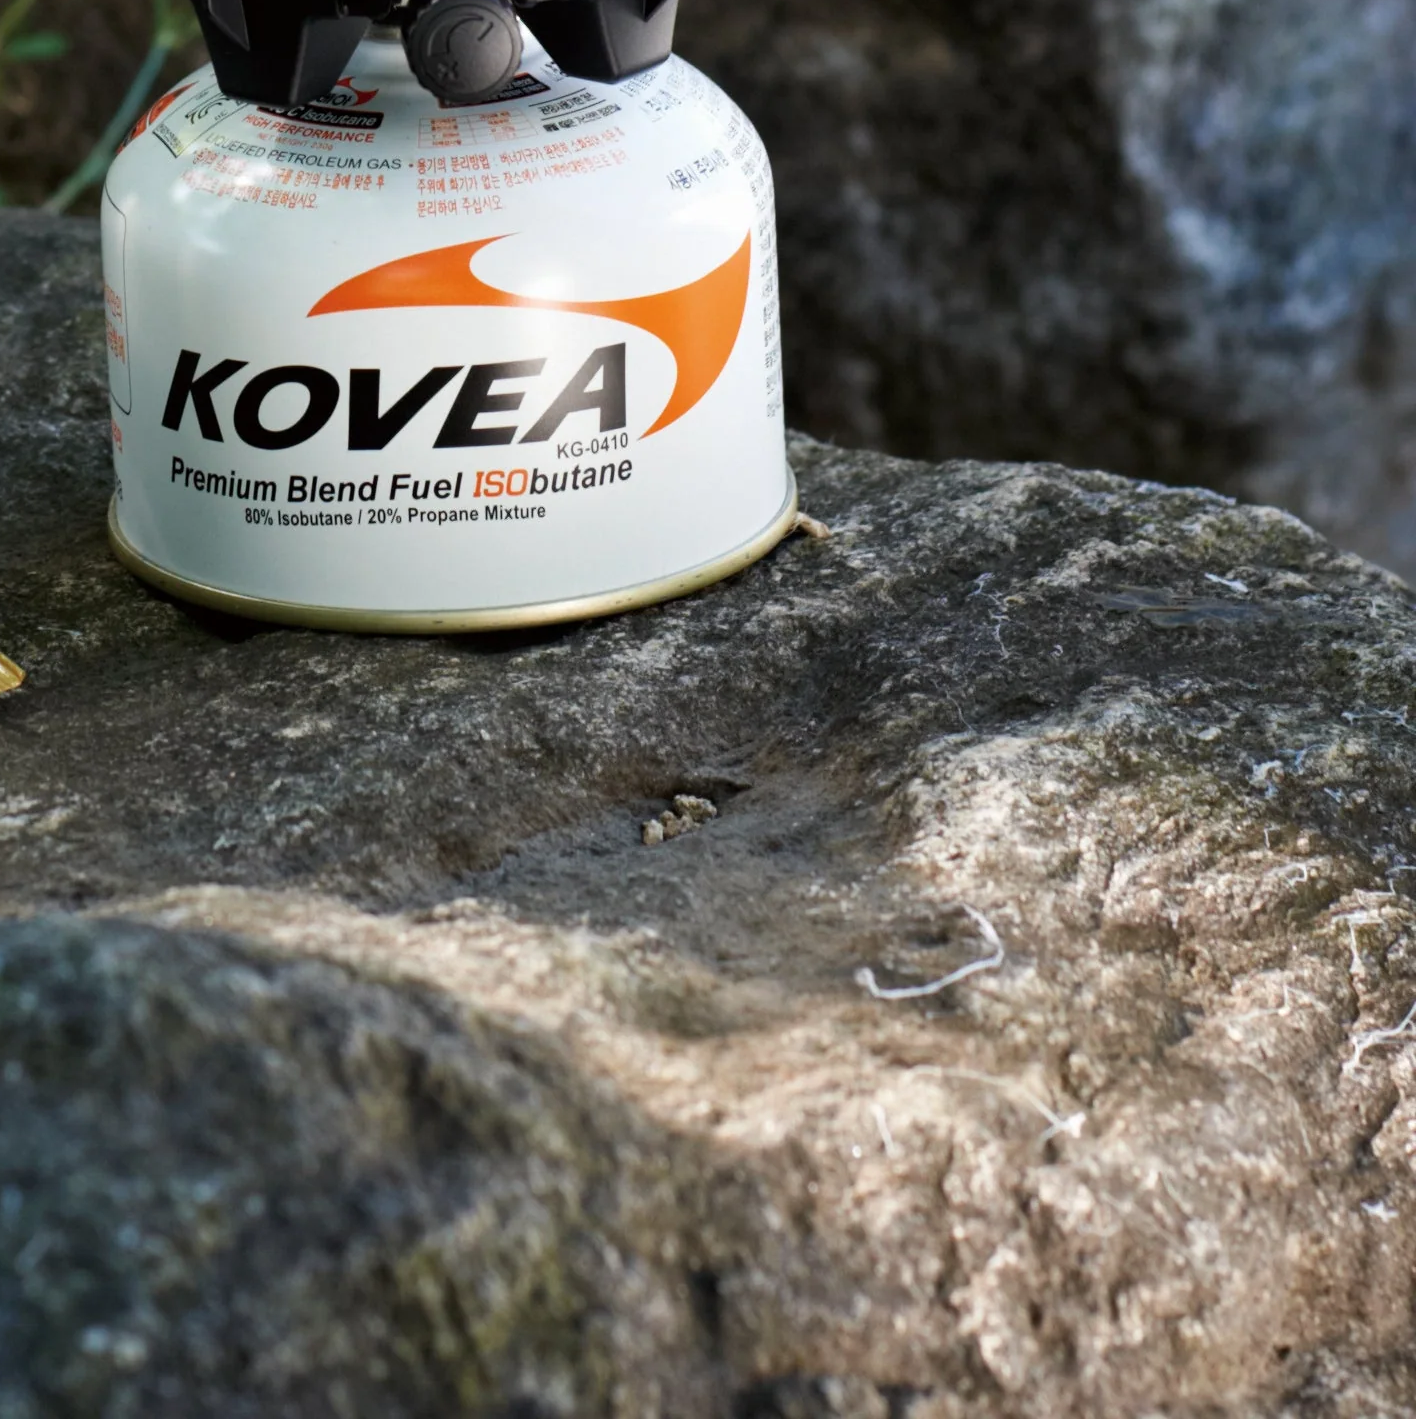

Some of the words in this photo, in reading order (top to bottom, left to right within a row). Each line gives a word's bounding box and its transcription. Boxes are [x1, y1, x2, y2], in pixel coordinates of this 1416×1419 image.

[244, 114, 270, 129] HIGH
[270, 121, 376, 144] PERFORMANCE
[300, 107, 377, 127] Isobutane
[204, 132, 267, 158] LIQUEFIED
[267, 149, 362, 170] PETROLEUM
[366, 158, 402, 171] GAS
[161, 341, 627, 451] KOVEA
[556, 432, 629, 459] KG-0410
[170, 455, 278, 503] Premium
[286, 474, 380, 504] Blend
[388, 471, 463, 501] Fuel
[472, 458, 633, 498] ISObutane
[244, 507, 274, 526] 80%
[277, 509, 353, 527] Isobutane
[367, 507, 402, 525] 20%
[407, 506, 479, 526] Propane
[484, 503, 546, 522] Mixture
